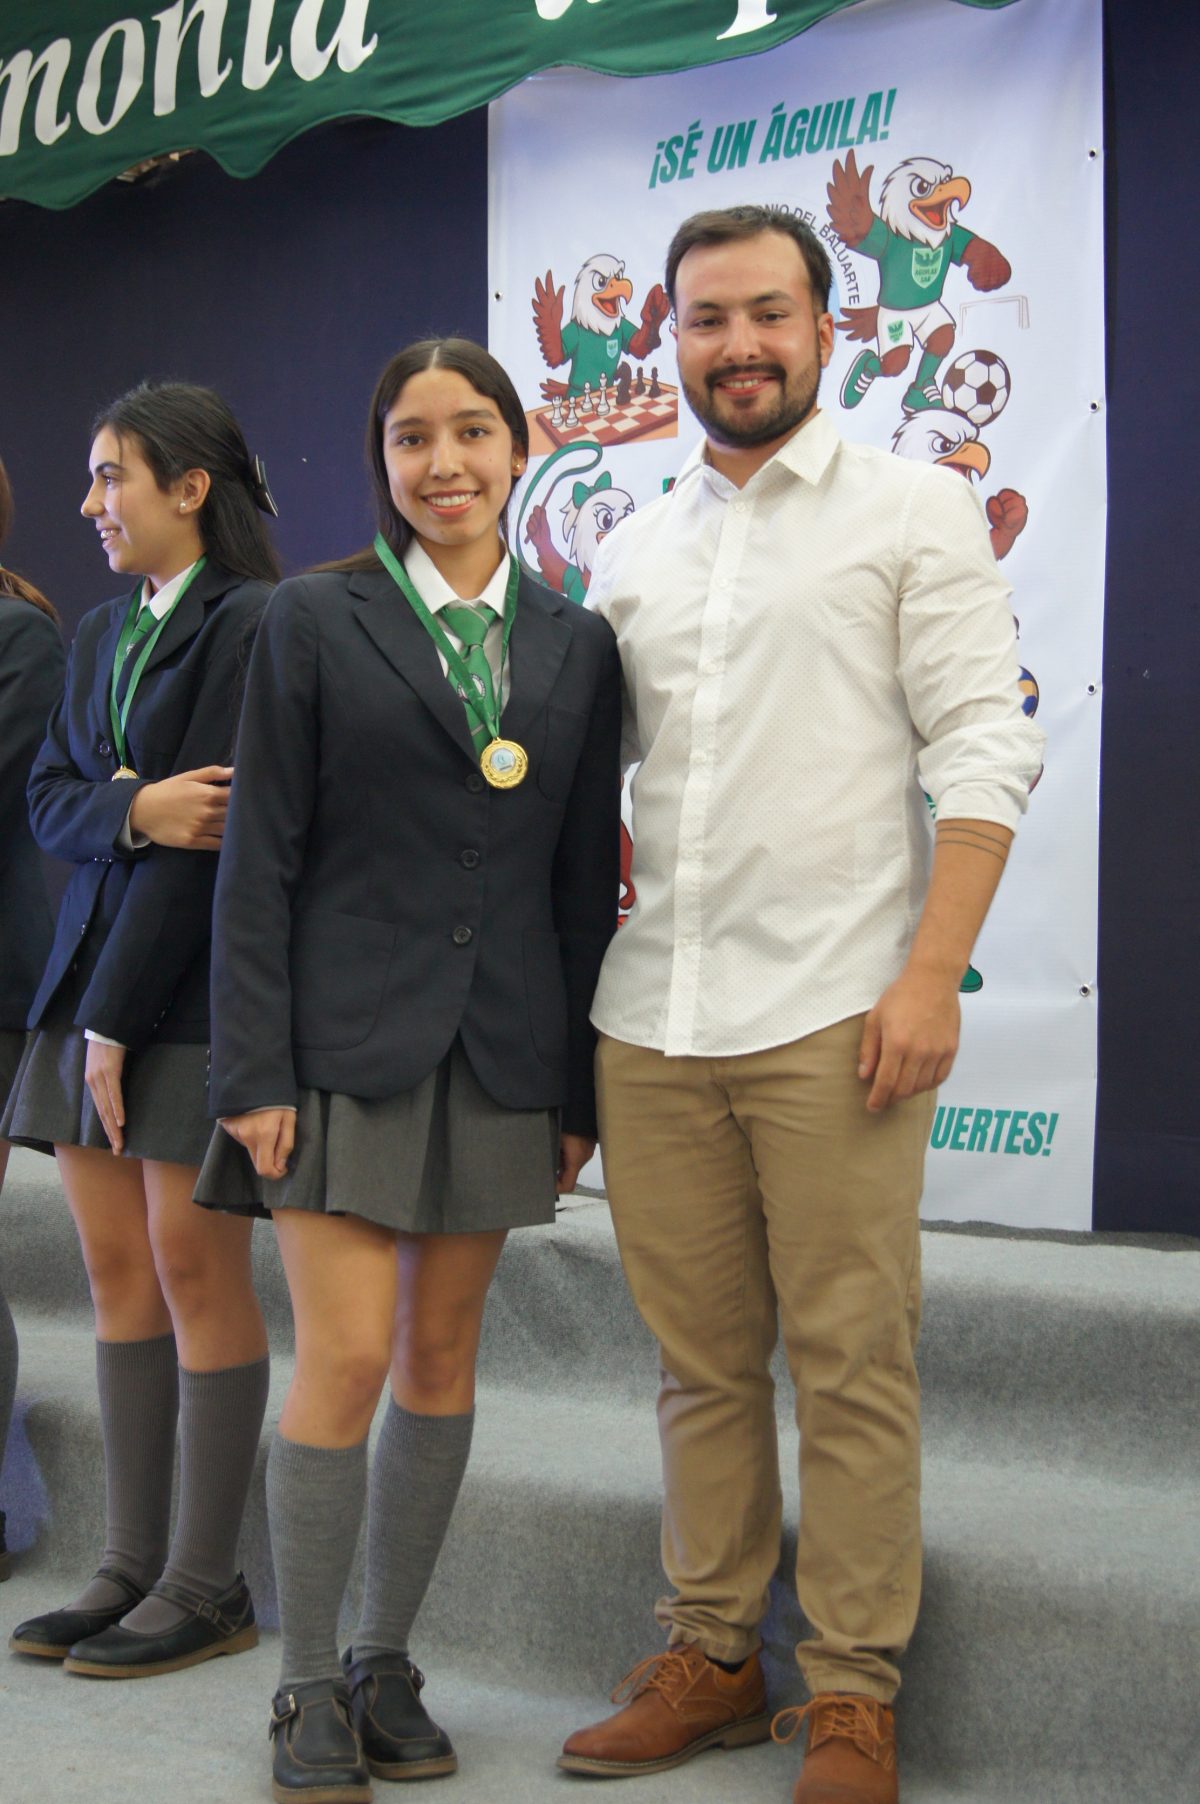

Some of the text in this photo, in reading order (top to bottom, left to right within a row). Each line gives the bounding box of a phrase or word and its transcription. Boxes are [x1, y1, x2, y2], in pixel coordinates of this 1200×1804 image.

[648, 88, 898, 189] ¡SÉ UN ÁGUILA!
[794, 206, 817, 230] DEL
[819, 224, 860, 306] BALUARTE
